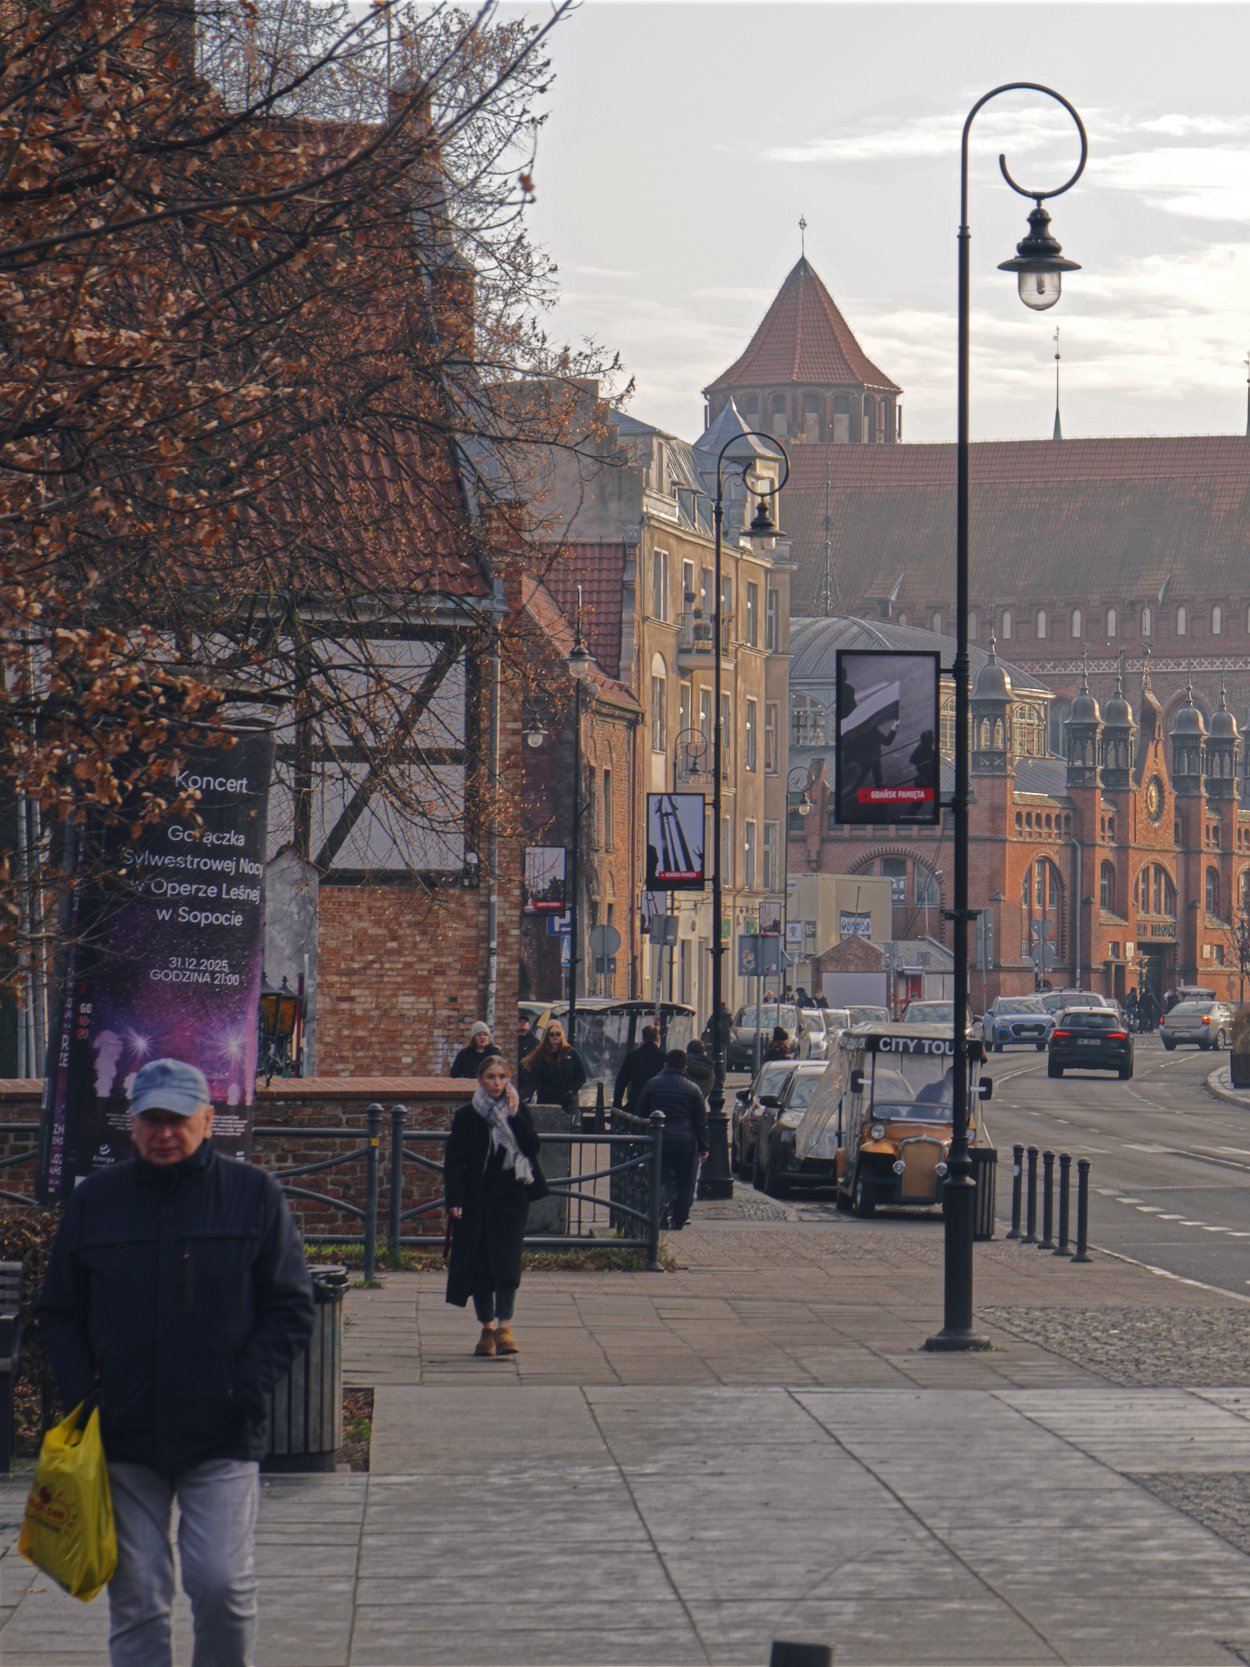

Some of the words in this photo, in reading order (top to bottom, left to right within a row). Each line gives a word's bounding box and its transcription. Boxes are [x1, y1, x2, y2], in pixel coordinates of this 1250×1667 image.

[175, 770, 249, 793] Koncert
[870, 788, 897, 799] GDAŃSK
[167, 825, 246, 847] Goączka
[239, 857, 264, 879] Nocy
[150, 877, 218, 898] Operze
[222, 882, 261, 905] Leśnej
[156, 908, 172, 921] w
[178, 906, 243, 927] Sopocie
[168, 956, 229, 971] 31.12.2025
[149, 968, 212, 984] GODZINA
[213, 972, 240, 986] 21:00
[879, 1037, 919, 1053] CITY
[921, 1039, 955, 1056] TOU
